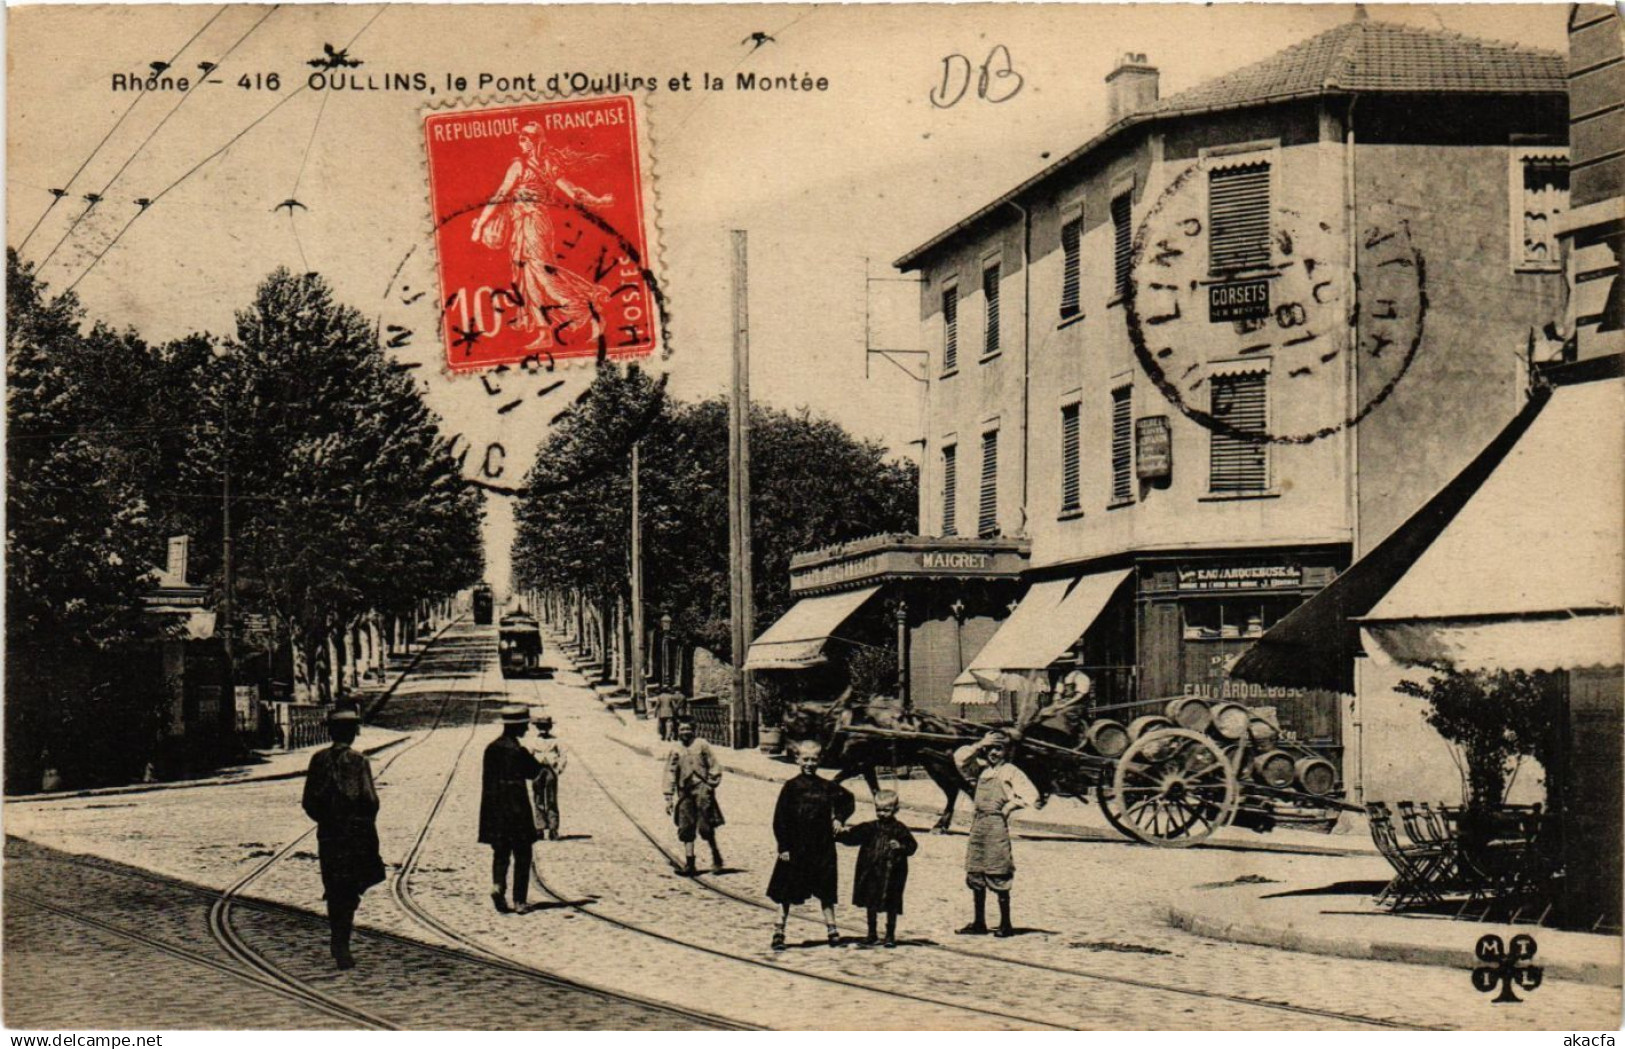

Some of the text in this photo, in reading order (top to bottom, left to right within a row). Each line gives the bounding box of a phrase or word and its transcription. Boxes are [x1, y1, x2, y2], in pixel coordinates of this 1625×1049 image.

[111, 69, 190, 91] Rhône
[237, 73, 281, 91] 416
[307, 71, 436, 95] OULLINS,
[446, 72, 468, 91] le
[478, 72, 536, 91] Pont
[546, 71, 658, 92] d'Oullins
[667, 71, 692, 91] et
[704, 72, 724, 91] la
[736, 71, 829, 91] Montée
[433, 106, 626, 142] REPUBLIQUE FRANÇAISE
[1211, 284, 1267, 306] CORSETS
[922, 553, 987, 568] MAIGRET
[1183, 683, 1210, 698] EAU
